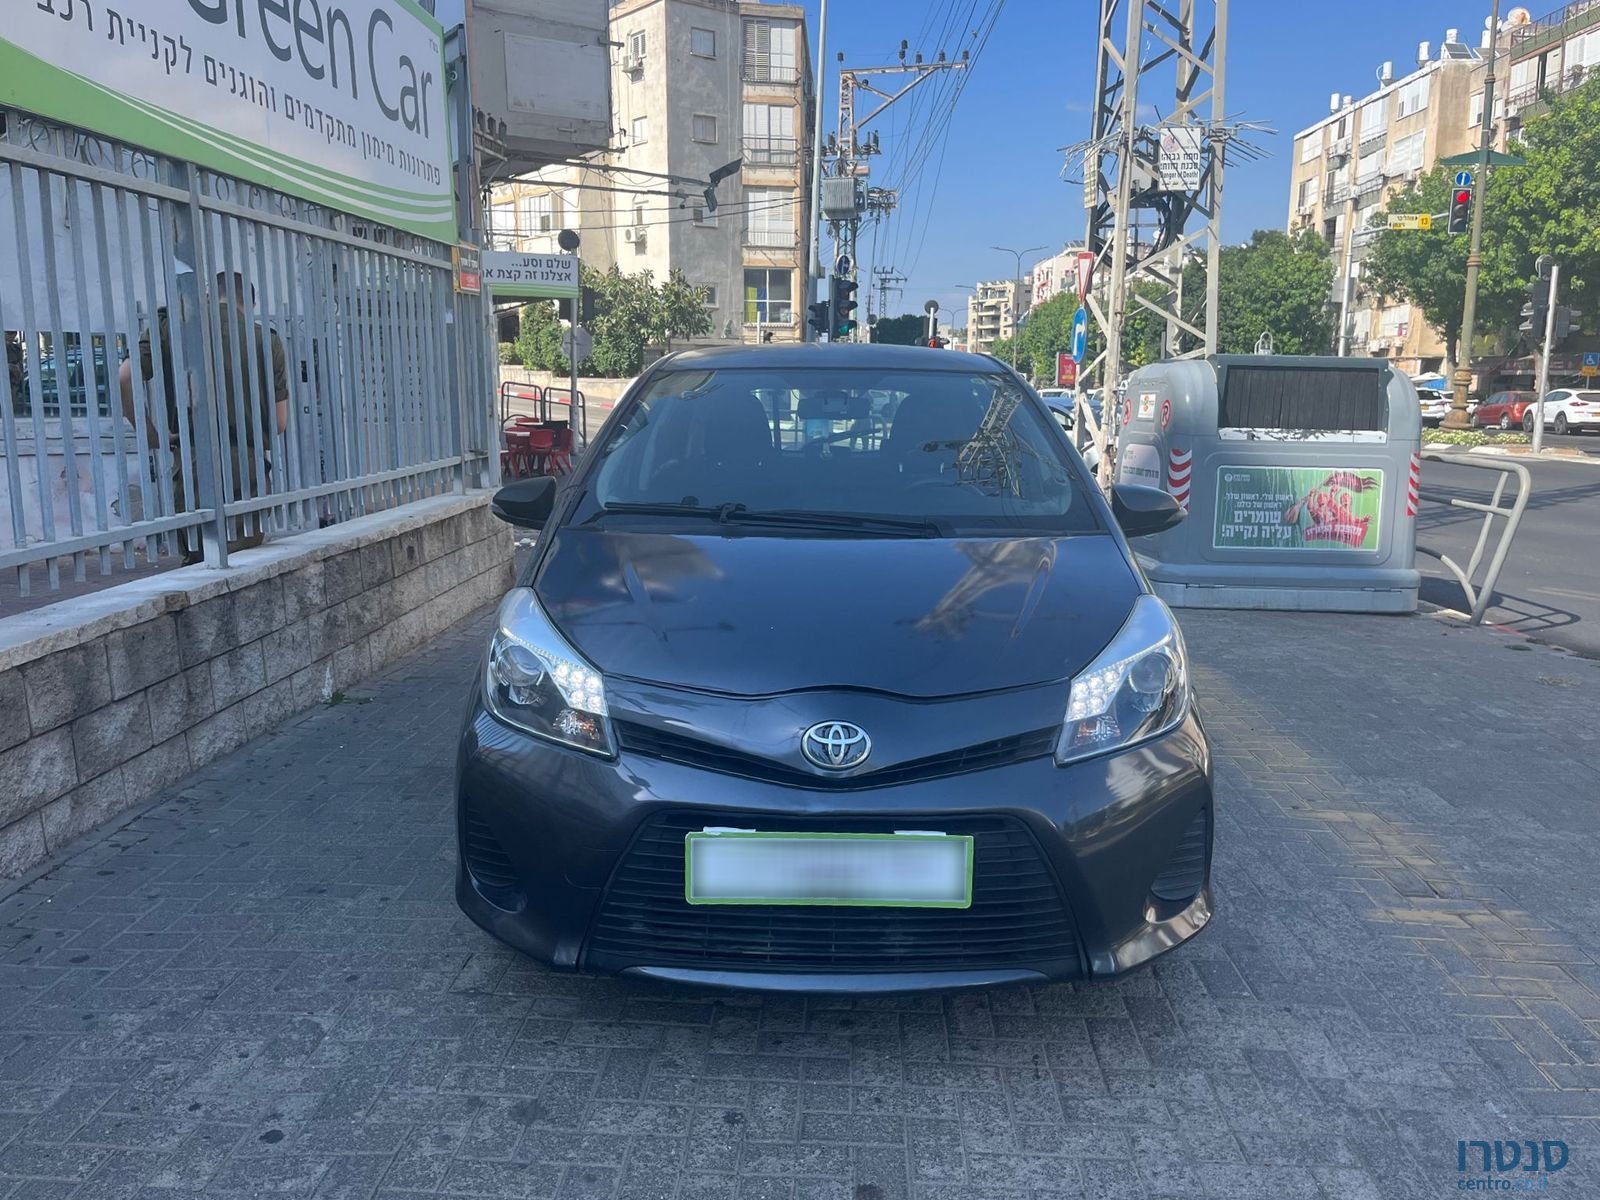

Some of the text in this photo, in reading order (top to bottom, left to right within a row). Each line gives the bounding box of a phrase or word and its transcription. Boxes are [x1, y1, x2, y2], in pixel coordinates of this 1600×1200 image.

[106, 8, 192, 75] לקניית
[204, 54, 277, 112] והוגנים
[368, 8, 433, 139] Car
[285, 93, 356, 148] מתקדמים
[361, 130, 395, 165] מימון
[399, 150, 441, 186] פתרונות
[497, 268, 521, 282] קצת
[511, 257, 571, 269] שלם וסע...
[524, 270, 538, 280] זה
[540, 270, 572, 281] אצלנו
[1234, 510, 1282, 524] שומרים
[1221, 523, 1292, 540] עליה נקייה!
